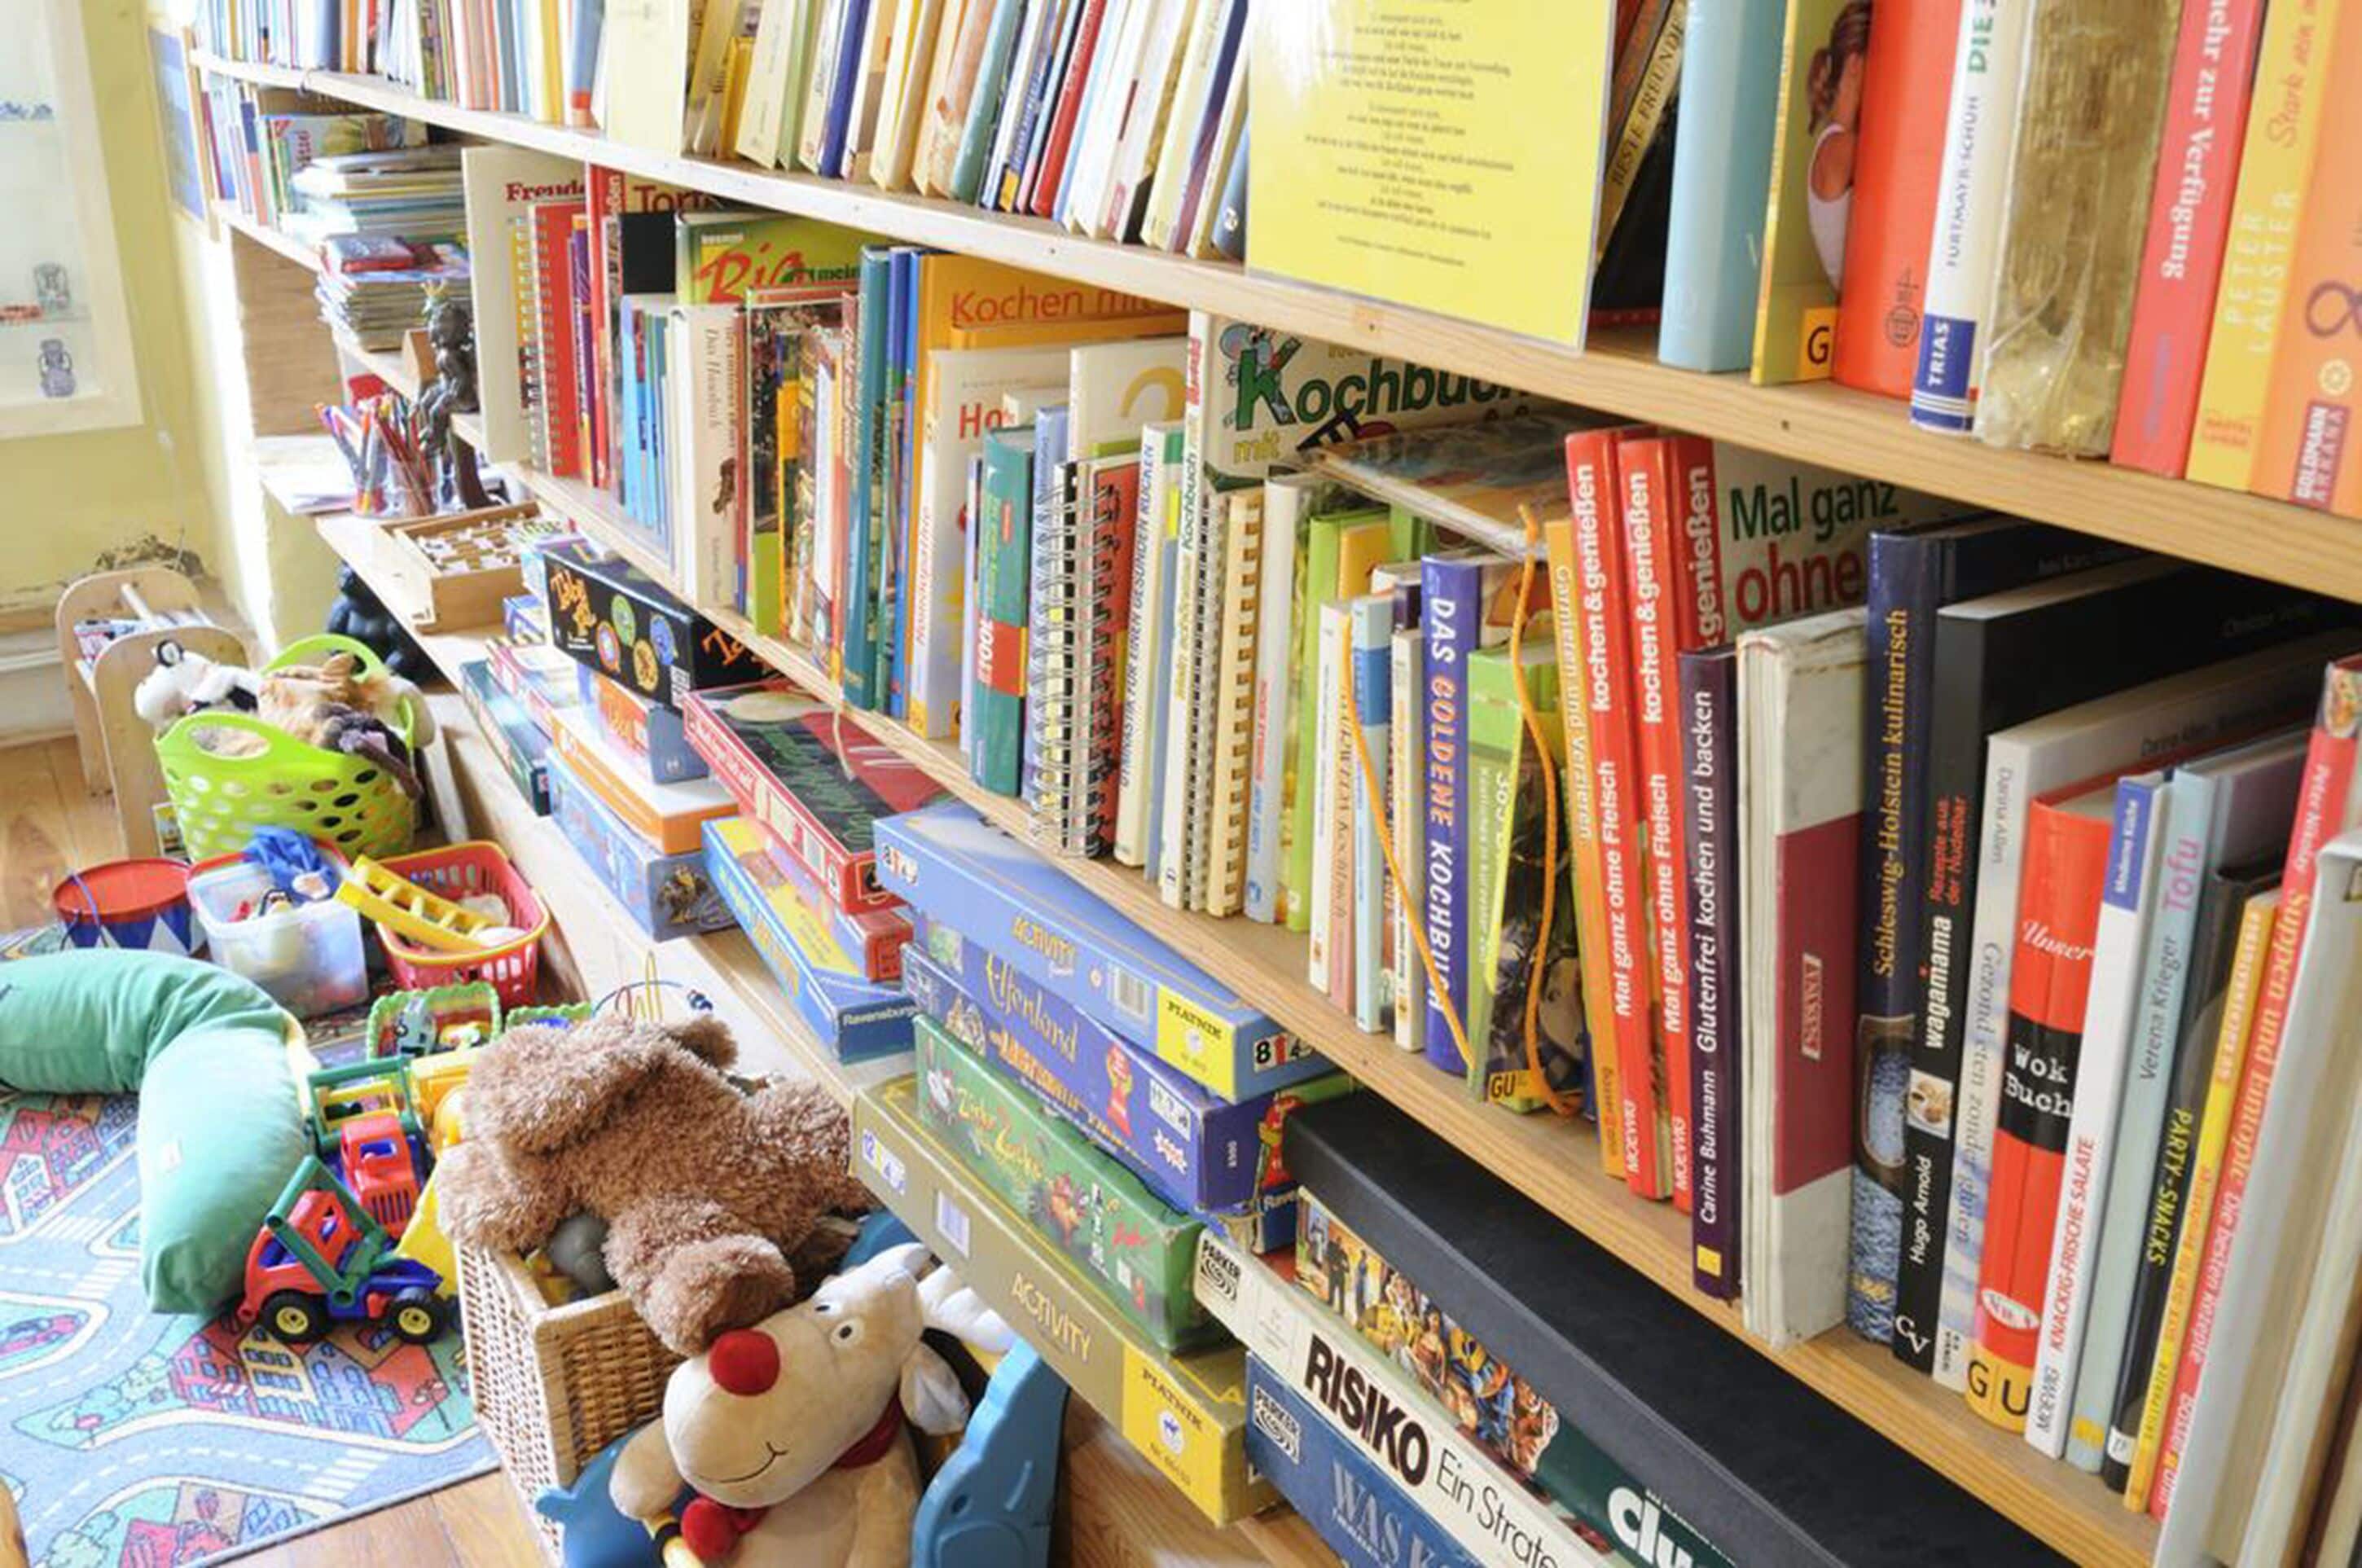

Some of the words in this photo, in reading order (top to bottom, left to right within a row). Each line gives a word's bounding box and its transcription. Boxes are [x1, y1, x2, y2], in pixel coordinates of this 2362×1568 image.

[1966, 13, 1995, 74] DIE
[2192, 67, 2219, 121] zur
[2158, 122, 2216, 281] Verfügung
[2222, 210, 2266, 327] PETER
[2245, 185, 2299, 355] LAUSTER
[951, 285, 1083, 323] Kochen
[1925, 321, 1951, 387] TRIAS
[1184, 451, 1200, 551] Kochbuch
[1730, 476, 1801, 542] Mal
[1811, 481, 1899, 542] ganz
[1735, 540, 1863, 623] ohne
[1431, 595, 1456, 662] DAS
[1553, 564, 1583, 681] Garnieren
[1565, 686, 1586, 731] und
[1880, 608, 1909, 744] kulinarisch
[1430, 672, 1456, 838] GOLDENE
[1692, 691, 1714, 776] backen
[1569, 736, 1596, 840] Verzieren
[1596, 759, 1620, 844] Fleisch
[1648, 771, 1672, 859] Fleisch
[1694, 786, 1714, 832] und
[1604, 849, 1624, 907] ohne
[1653, 864, 1676, 922] ohne
[1694, 842, 1716, 926] kochen
[1872, 752, 1908, 977] Schleswig-Holstein
[2159, 835, 2202, 914] Tofu
[1011, 915, 1078, 966] ACTIVITY
[1609, 912, 1632, 969] ganz
[1659, 927, 1683, 985] ganz
[2149, 934, 2185, 1010] Krieger
[2263, 887, 2309, 1000] Suppen
[1612, 972, 1631, 1017] Mal
[1662, 988, 1683, 1033] Mal
[1695, 933, 1718, 1052] Glutenfrei
[1922, 916, 1958, 1049] wagamama
[1971, 941, 2003, 1031] Gezond
[1166, 999, 1224, 1042] PIATNIK
[2137, 1012, 2167, 1081] Verena
[2253, 1006, 2284, 1065] und
[1490, 1074, 1517, 1100] GU
[1970, 1039, 1990, 1086] eten
[2004, 1073, 2074, 1118] Buch
[2013, 1043, 2069, 1086] Wok
[1699, 1070, 1716, 1158] Buhmann
[1961, 1094, 1988, 1169] zonder
[1700, 1166, 1717, 1223] Carine
[1911, 1154, 1933, 1214] Arnold
[1201, 1238, 1242, 1280] PARKER
[1908, 1217, 1931, 1263] Hugo
[2044, 1204, 2087, 1351] KNACKIG-FRISCHE
[2068, 1137, 2095, 1202] SALATE
[1010, 1271, 1091, 1366] ACTIVITY
[1142, 1368, 1203, 1434] PIATNIK
[1254, 1386, 1300, 1438] PARKER
[1305, 1333, 1430, 1489] RISIKO
[1436, 1447, 1475, 1513] Ein
[1332, 1461, 1402, 1563] WAS
